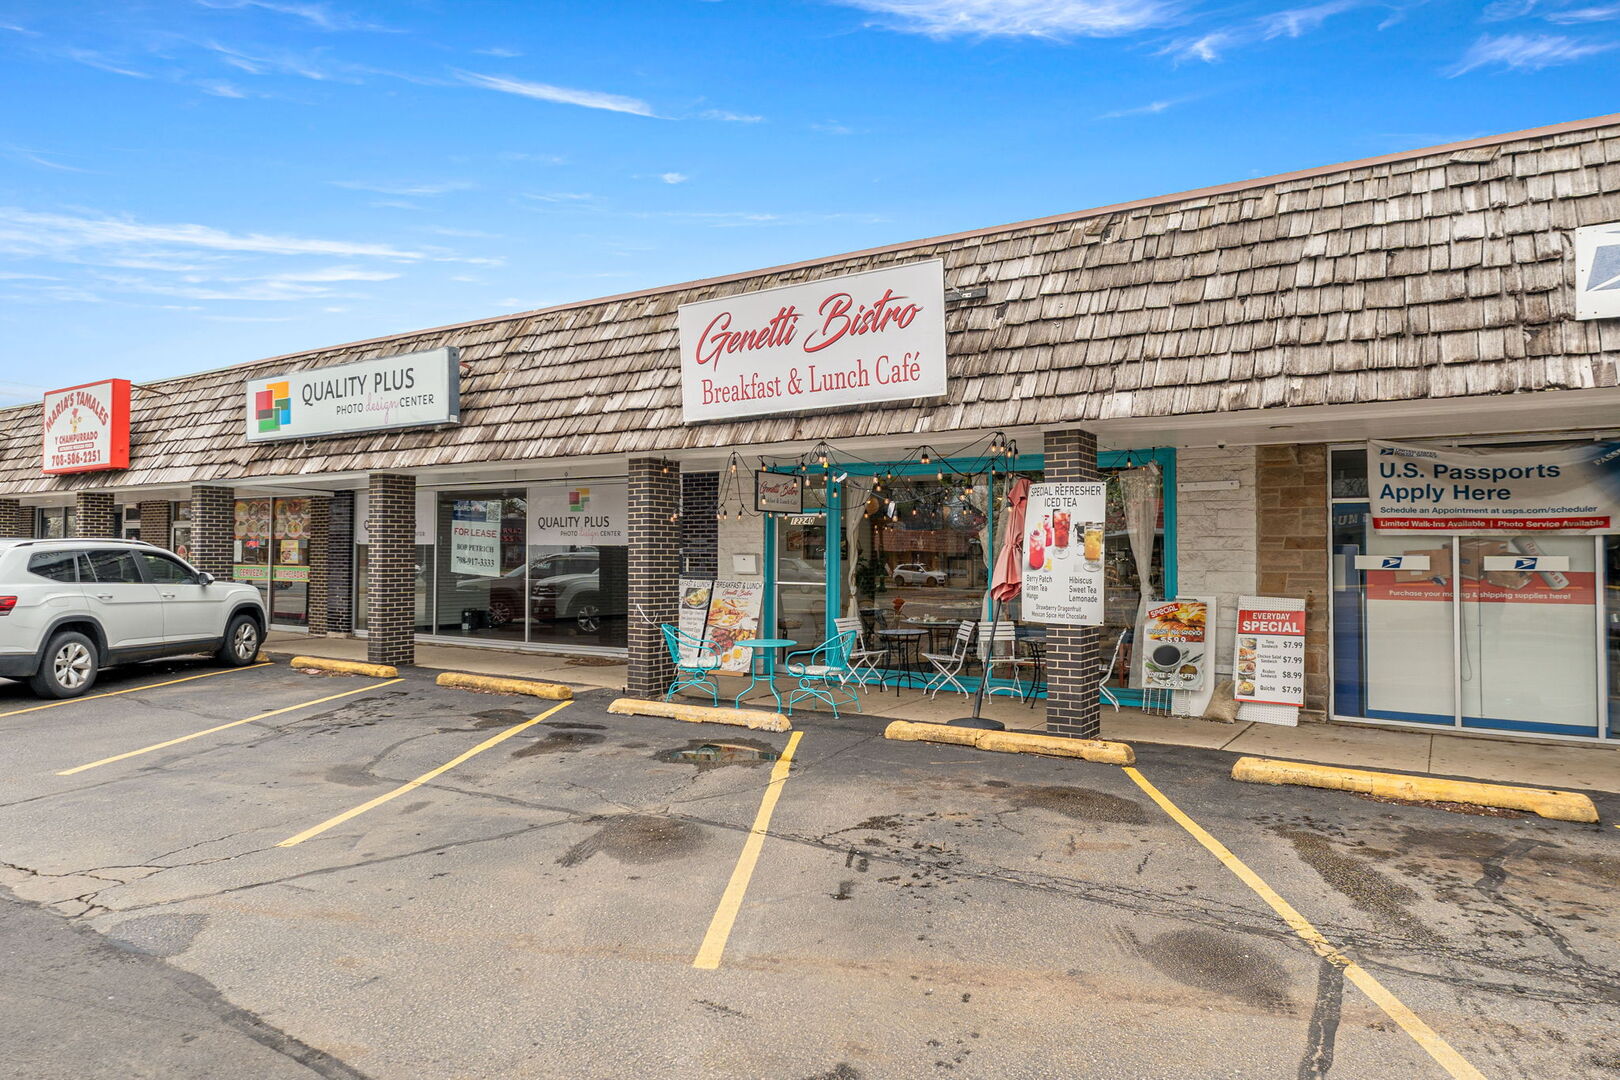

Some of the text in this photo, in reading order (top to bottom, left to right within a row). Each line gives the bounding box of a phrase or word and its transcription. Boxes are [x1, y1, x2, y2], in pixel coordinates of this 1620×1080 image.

[695, 288, 924, 372] Genetti Bistro
[701, 351, 921, 405] Breakfast & Lunch Café
[302, 368, 414, 406] QUALITY PLUS
[46, 391, 109, 433] MARIA'S TAMALES
[336, 392, 434, 424] PHOTO design CENTER
[60, 431, 98, 444] CHAMPURRADO
[1380, 462, 1560, 483] U.S. Passports
[1031, 486, 1101, 497] SPECIAL REFRESHER
[1380, 483, 1511, 503] Apply Here
[1045, 498, 1077, 507] ICED TEA
[1502, 506, 1598, 515] usps.com/scheduler
[538, 516, 610, 530] QUALITY PLUS
[454, 528, 469, 536] FOR
[471, 529, 497, 538] LEASE
[1039, 575, 1052, 583] Patch
[1069, 576, 1092, 584] Hibiscus
[1151, 605, 1179, 618] SPECIAL
[1242, 621, 1300, 633] SPECIAL
[1283, 656, 1302, 664] $7.99
[1282, 671, 1302, 679] $8.99
[1282, 686, 1302, 694] $7.99
